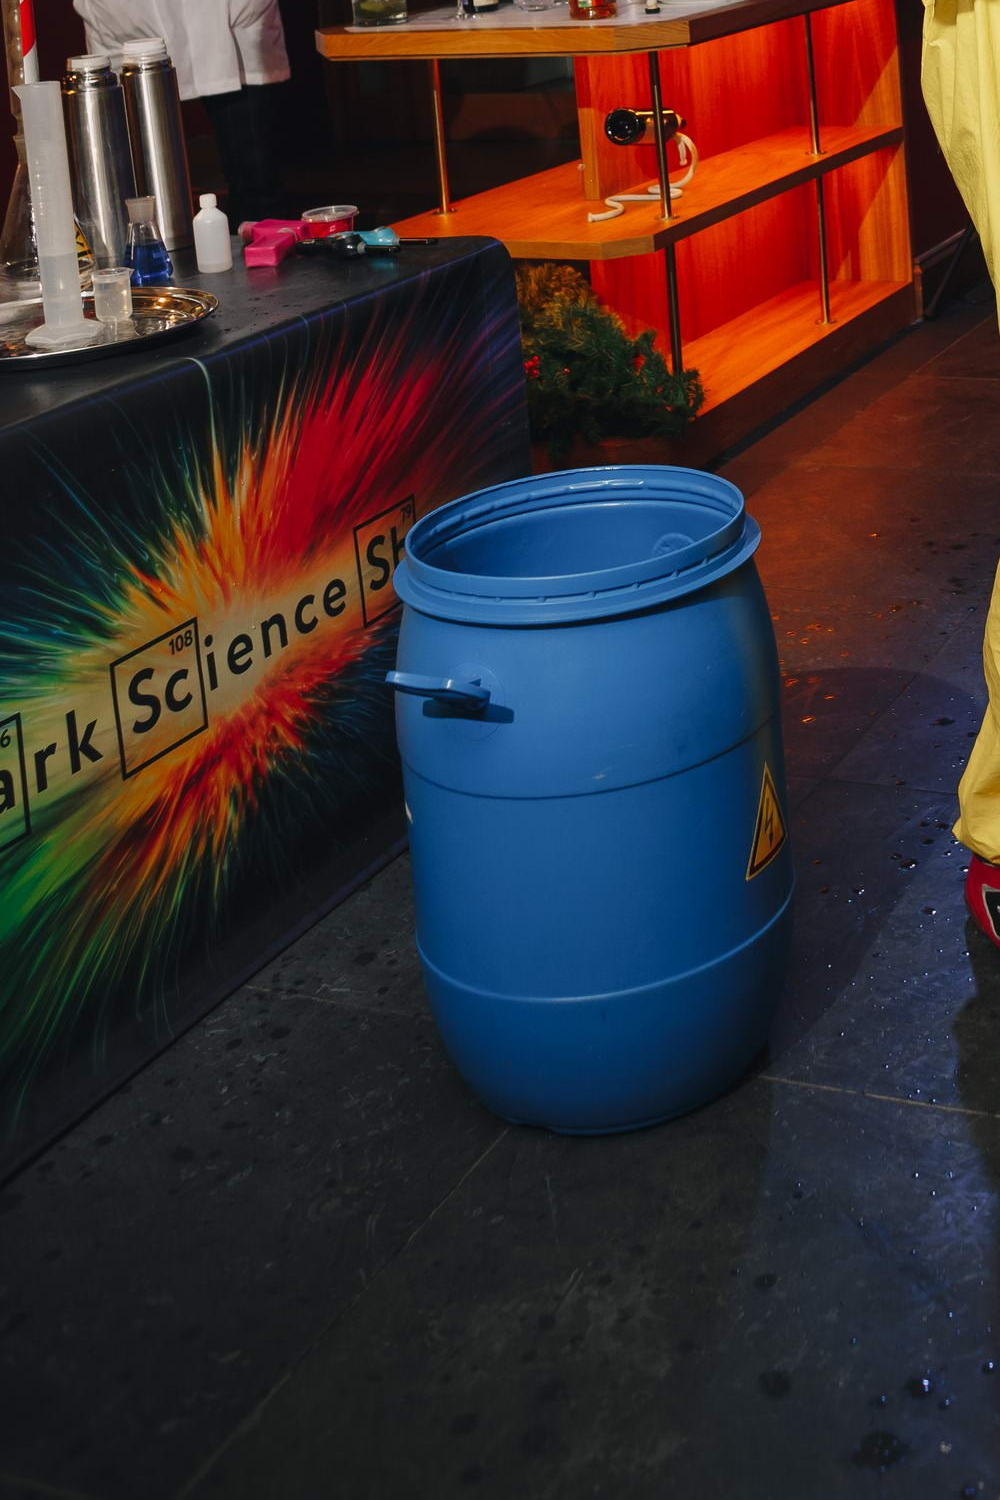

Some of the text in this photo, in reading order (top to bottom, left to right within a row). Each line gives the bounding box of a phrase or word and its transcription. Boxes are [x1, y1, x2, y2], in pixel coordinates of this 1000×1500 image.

[401, 504, 412, 522] 79
[168, 629, 194, 655] 108
[128, 578, 347, 734] Science
